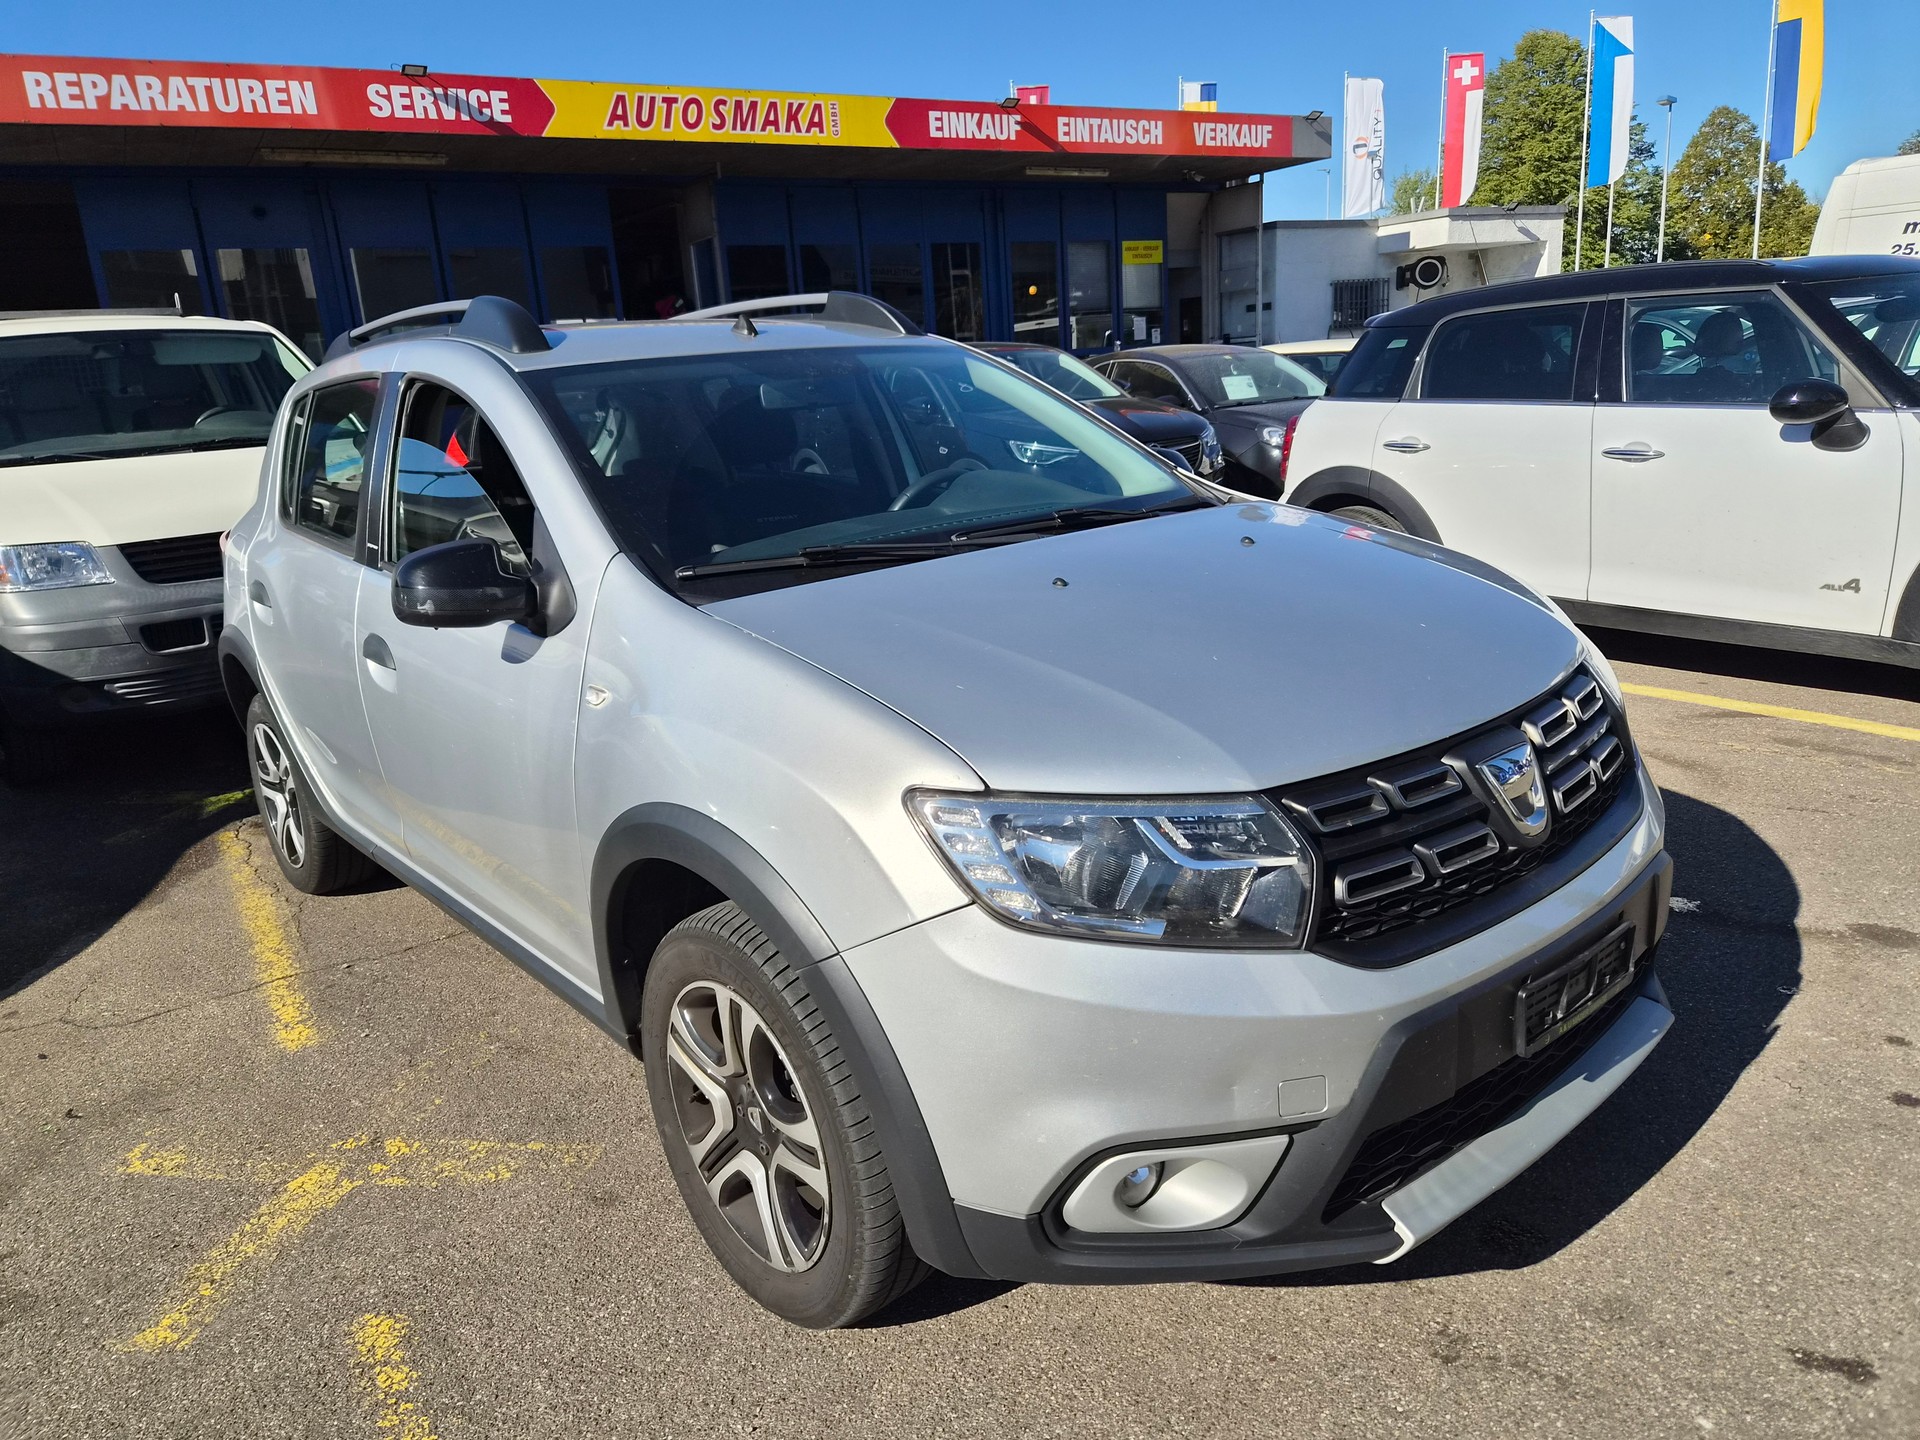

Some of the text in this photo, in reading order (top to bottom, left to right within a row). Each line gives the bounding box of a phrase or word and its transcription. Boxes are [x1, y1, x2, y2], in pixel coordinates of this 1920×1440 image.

[23, 71, 318, 115] REPARATUREN
[368, 84, 512, 123] SERVICE
[606, 93, 826, 135] AUTO SMAKA
[830, 102, 839, 136] GMBH
[929, 110, 1021, 140] EINKAUF
[1057, 116, 1163, 145] EINTAUSCH
[1193, 122, 1272, 148] VERKAUF
[1373, 117, 1382, 181] QUALITY
